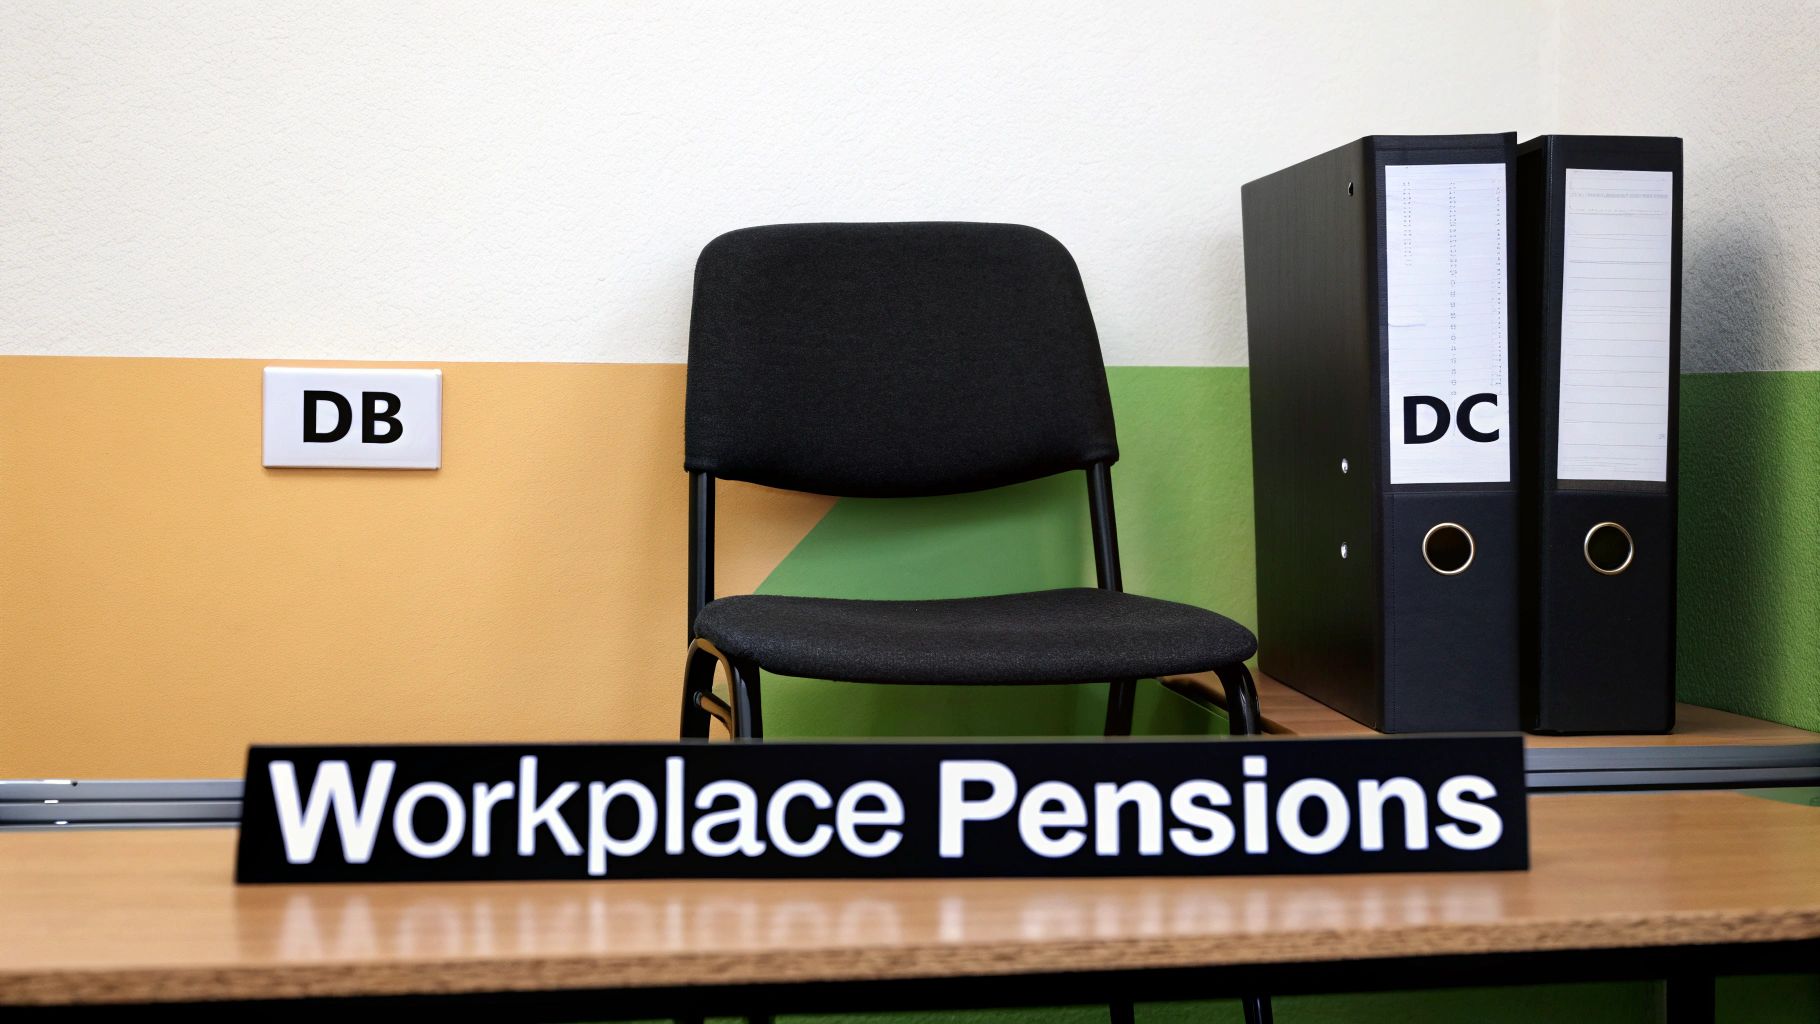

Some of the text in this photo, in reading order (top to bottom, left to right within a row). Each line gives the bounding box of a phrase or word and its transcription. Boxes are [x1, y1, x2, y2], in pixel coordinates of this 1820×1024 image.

[303, 391, 403, 443] DB
[1404, 393, 1500, 444] DC
[269, 756, 1503, 875] Workplace Pensions
